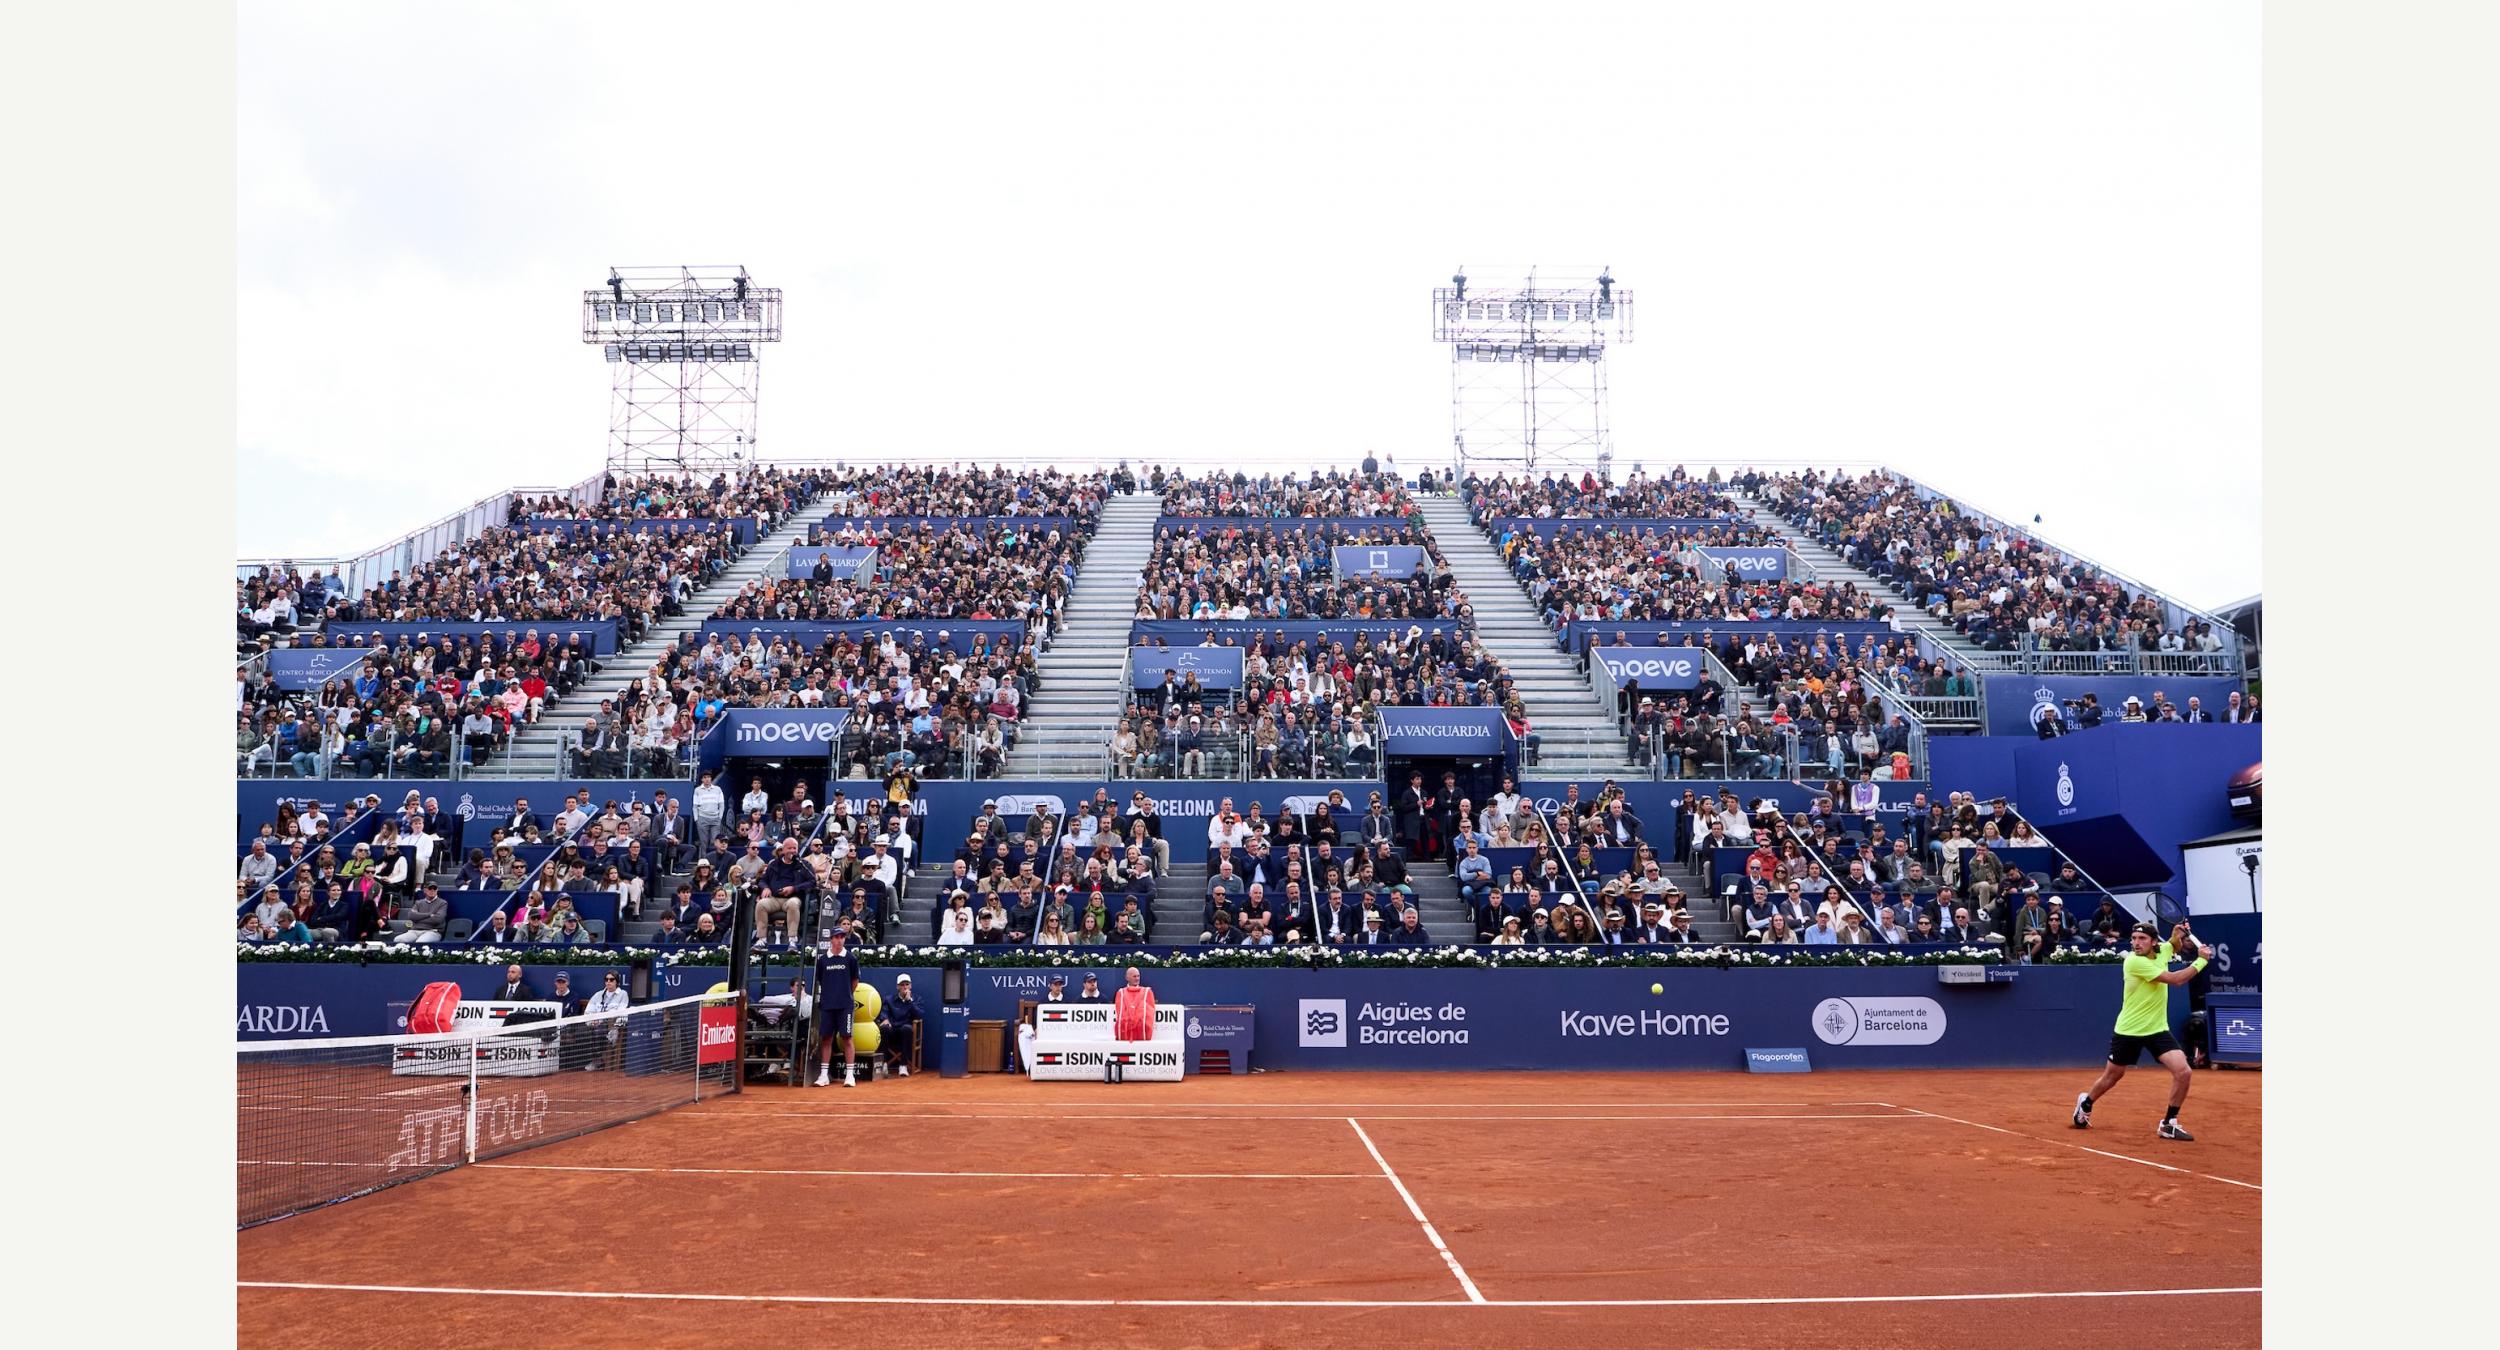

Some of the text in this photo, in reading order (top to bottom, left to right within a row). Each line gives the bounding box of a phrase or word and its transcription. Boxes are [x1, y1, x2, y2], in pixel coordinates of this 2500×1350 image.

[736, 722, 835, 742] moeve
[1388, 725, 1491, 737] LA VANGUARDIA
[1071, 1010, 1107, 1022] ISDIN
[1357, 1001, 1466, 1026] Aigües de
[1864, 1008, 1927, 1019] Ajuntament de
[1560, 1009, 1730, 1036] Kave Home
[1864, 1019, 1928, 1030] Barcelona
[701, 1022, 736, 1047] Emirates
[1359, 1025, 1469, 1045] Barcelona
[425, 1047, 461, 1060] ISDIN
[495, 1047, 531, 1060] ISDIN
[1065, 1052, 1103, 1065] ISDIN
[1139, 1052, 1177, 1065] ISDIN
[1751, 1053, 1804, 1062] Flogoprofen
[1035, 1067, 1104, 1075] LOVE YOUR SKIN
[1133, 1067, 1156, 1075] YOUR
[1158, 1067, 1177, 1075] SKIN
